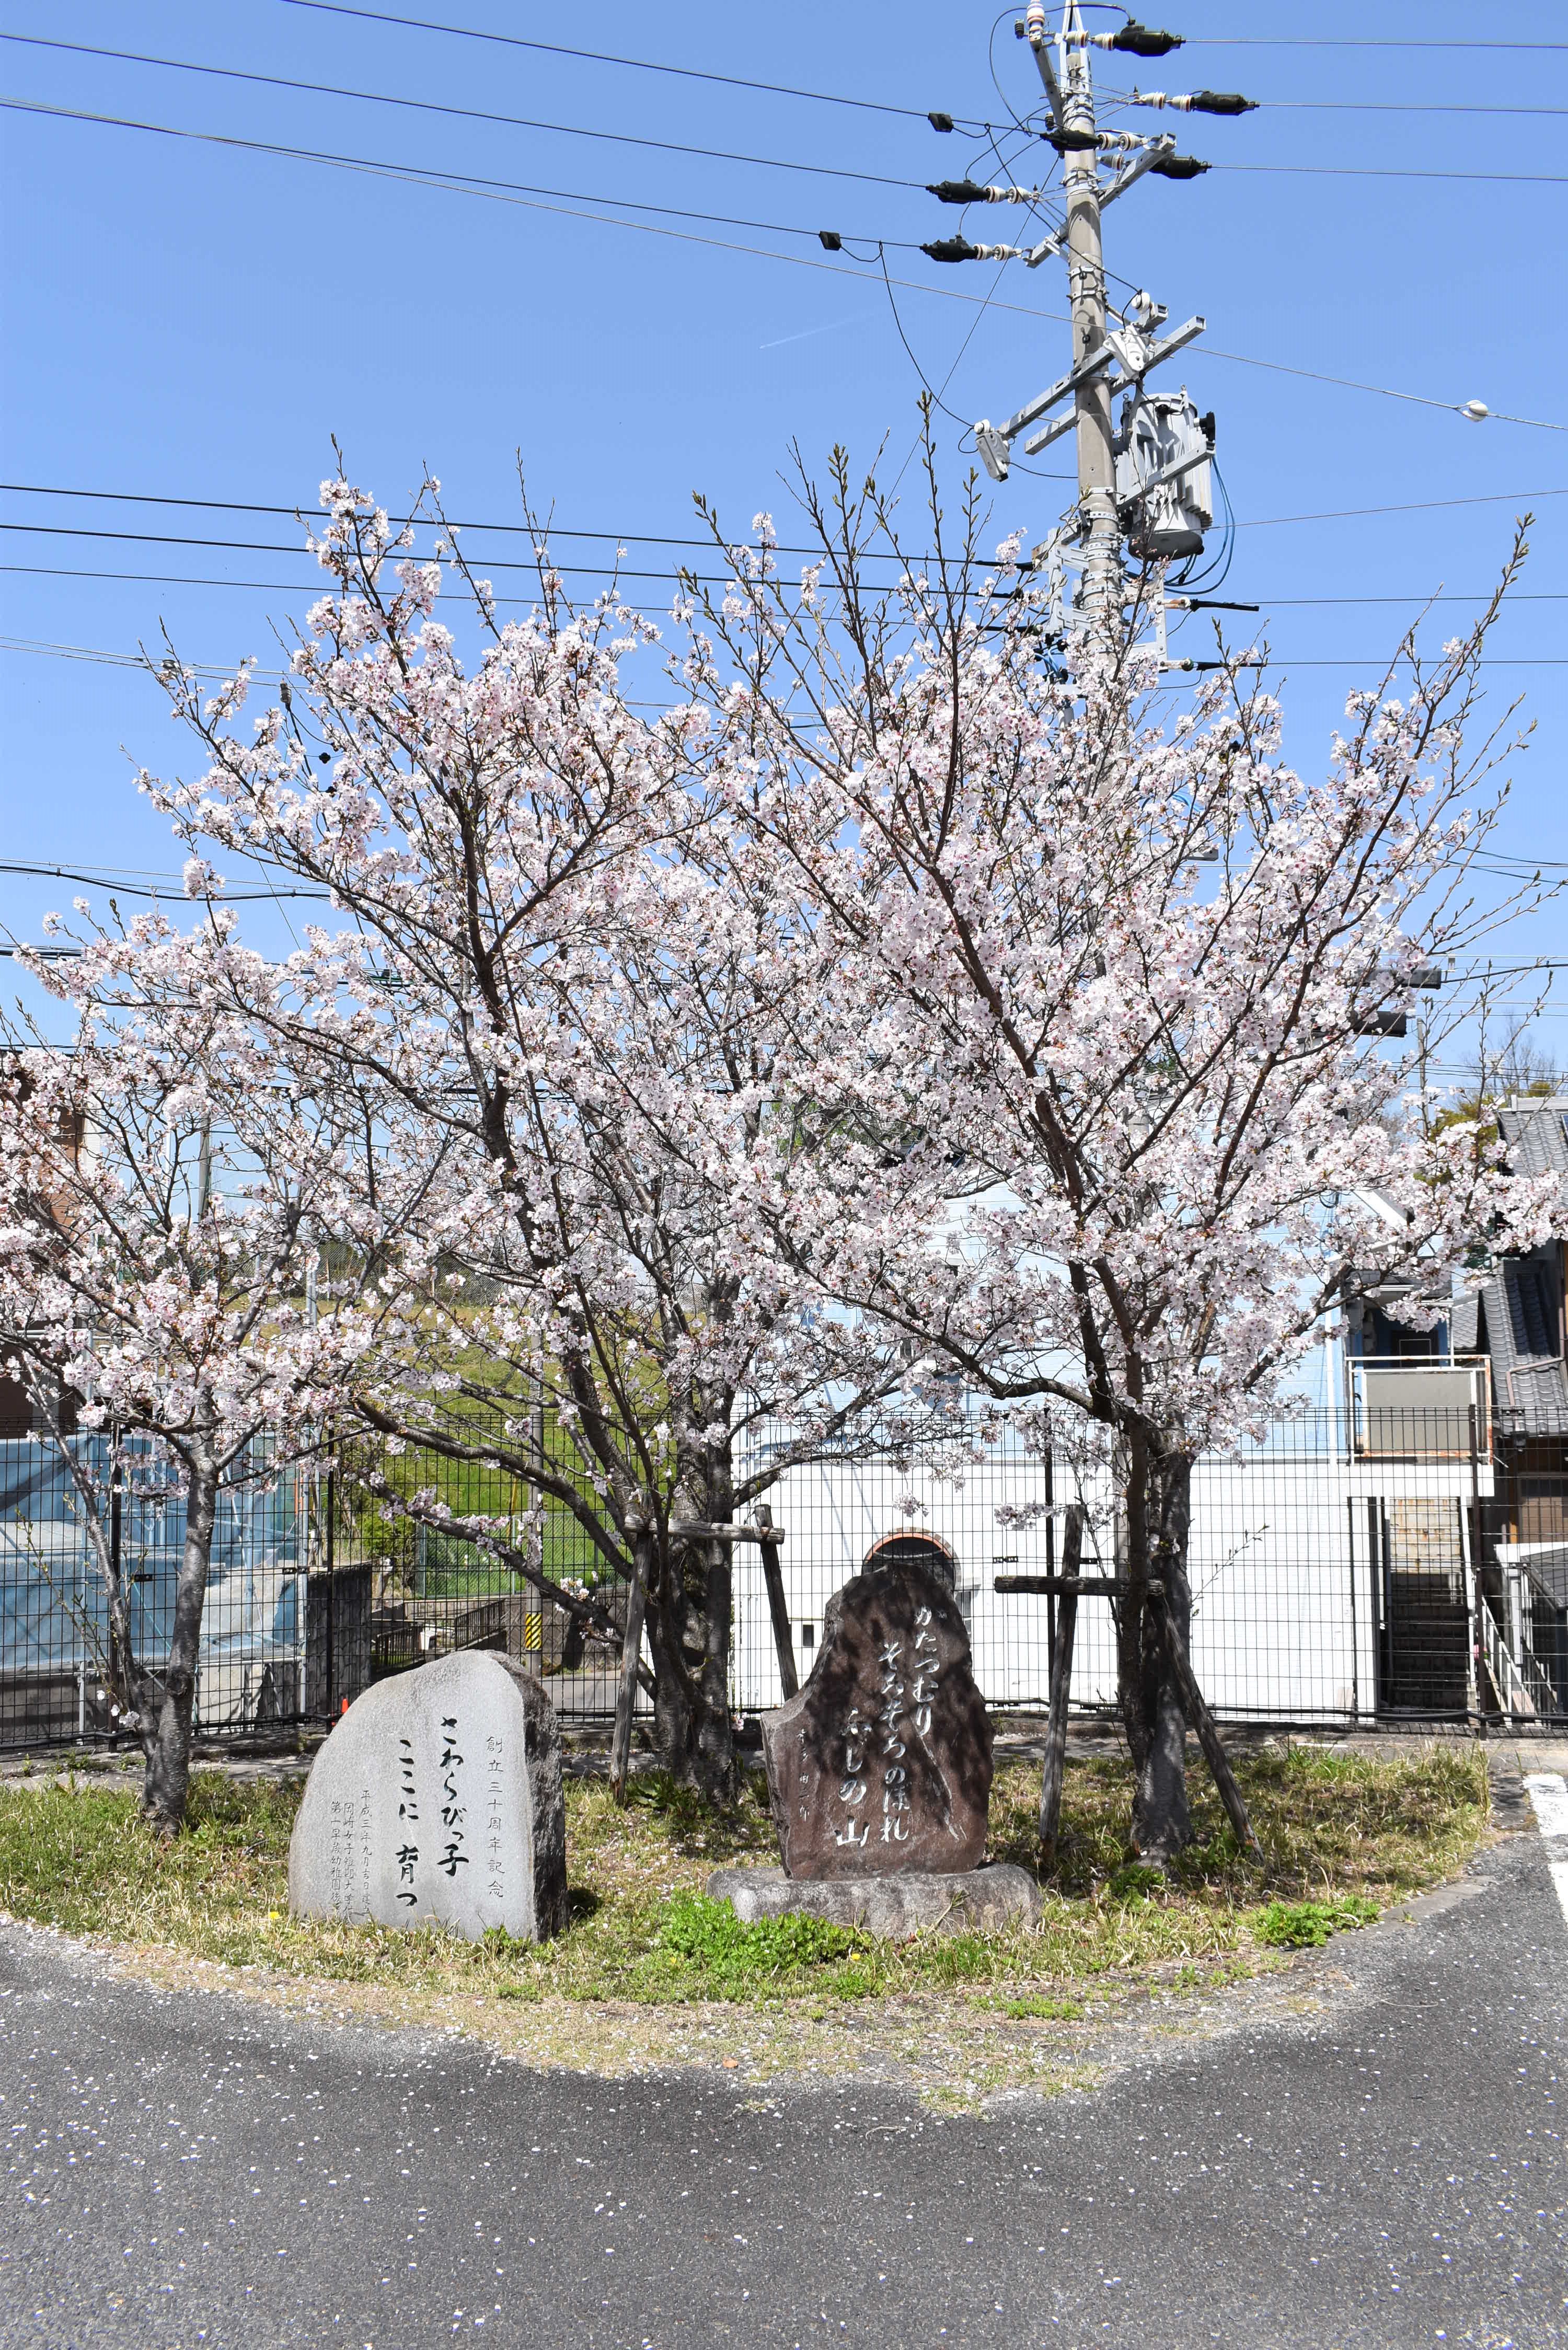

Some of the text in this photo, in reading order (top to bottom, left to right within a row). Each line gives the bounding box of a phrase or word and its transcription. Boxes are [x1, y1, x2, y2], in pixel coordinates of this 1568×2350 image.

[395, 1738, 419, 1907] ここに育つ
[436, 1715, 469, 1877] さわらびっ子
[486, 1735, 505, 1898] 創立三十周年記念
